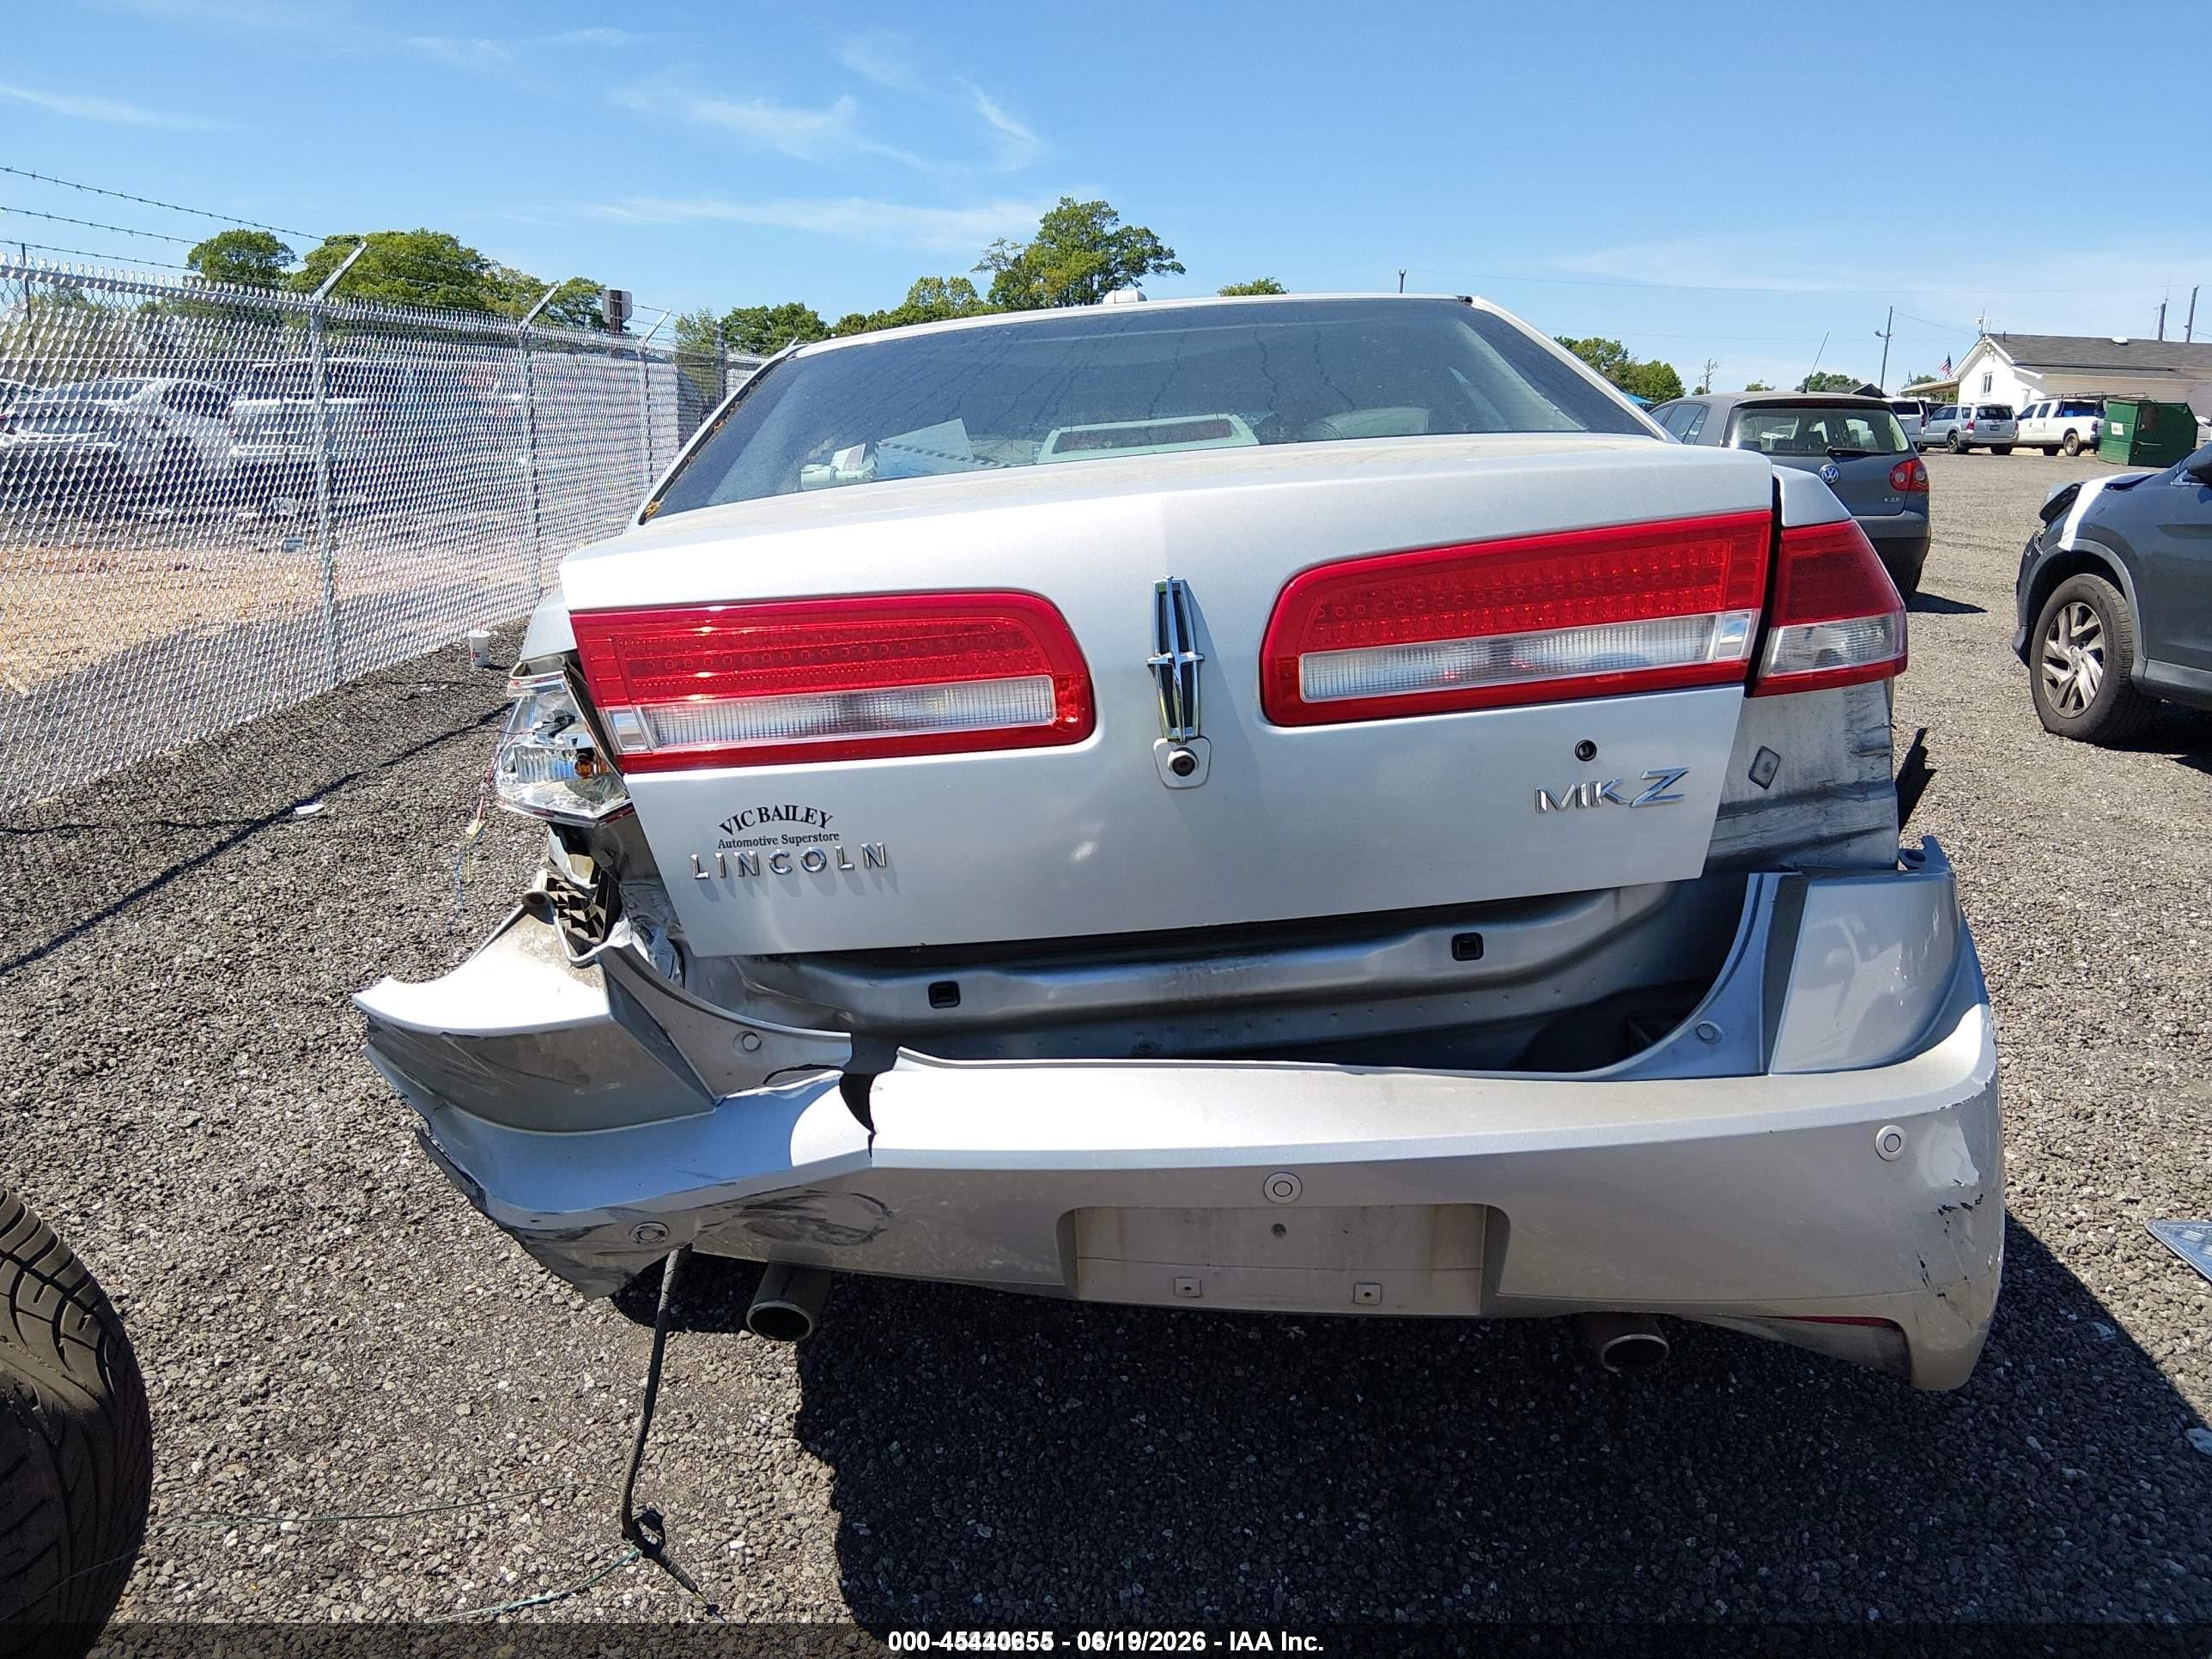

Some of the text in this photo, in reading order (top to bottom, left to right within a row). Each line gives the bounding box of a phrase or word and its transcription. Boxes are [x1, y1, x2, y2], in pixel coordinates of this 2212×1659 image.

[1534, 766, 1691, 813] MKZ
[719, 805, 834, 836] VIC BAILEY
[718, 832, 840, 849] Automotive Superstore
[690, 842, 887, 879] LINCOLN
